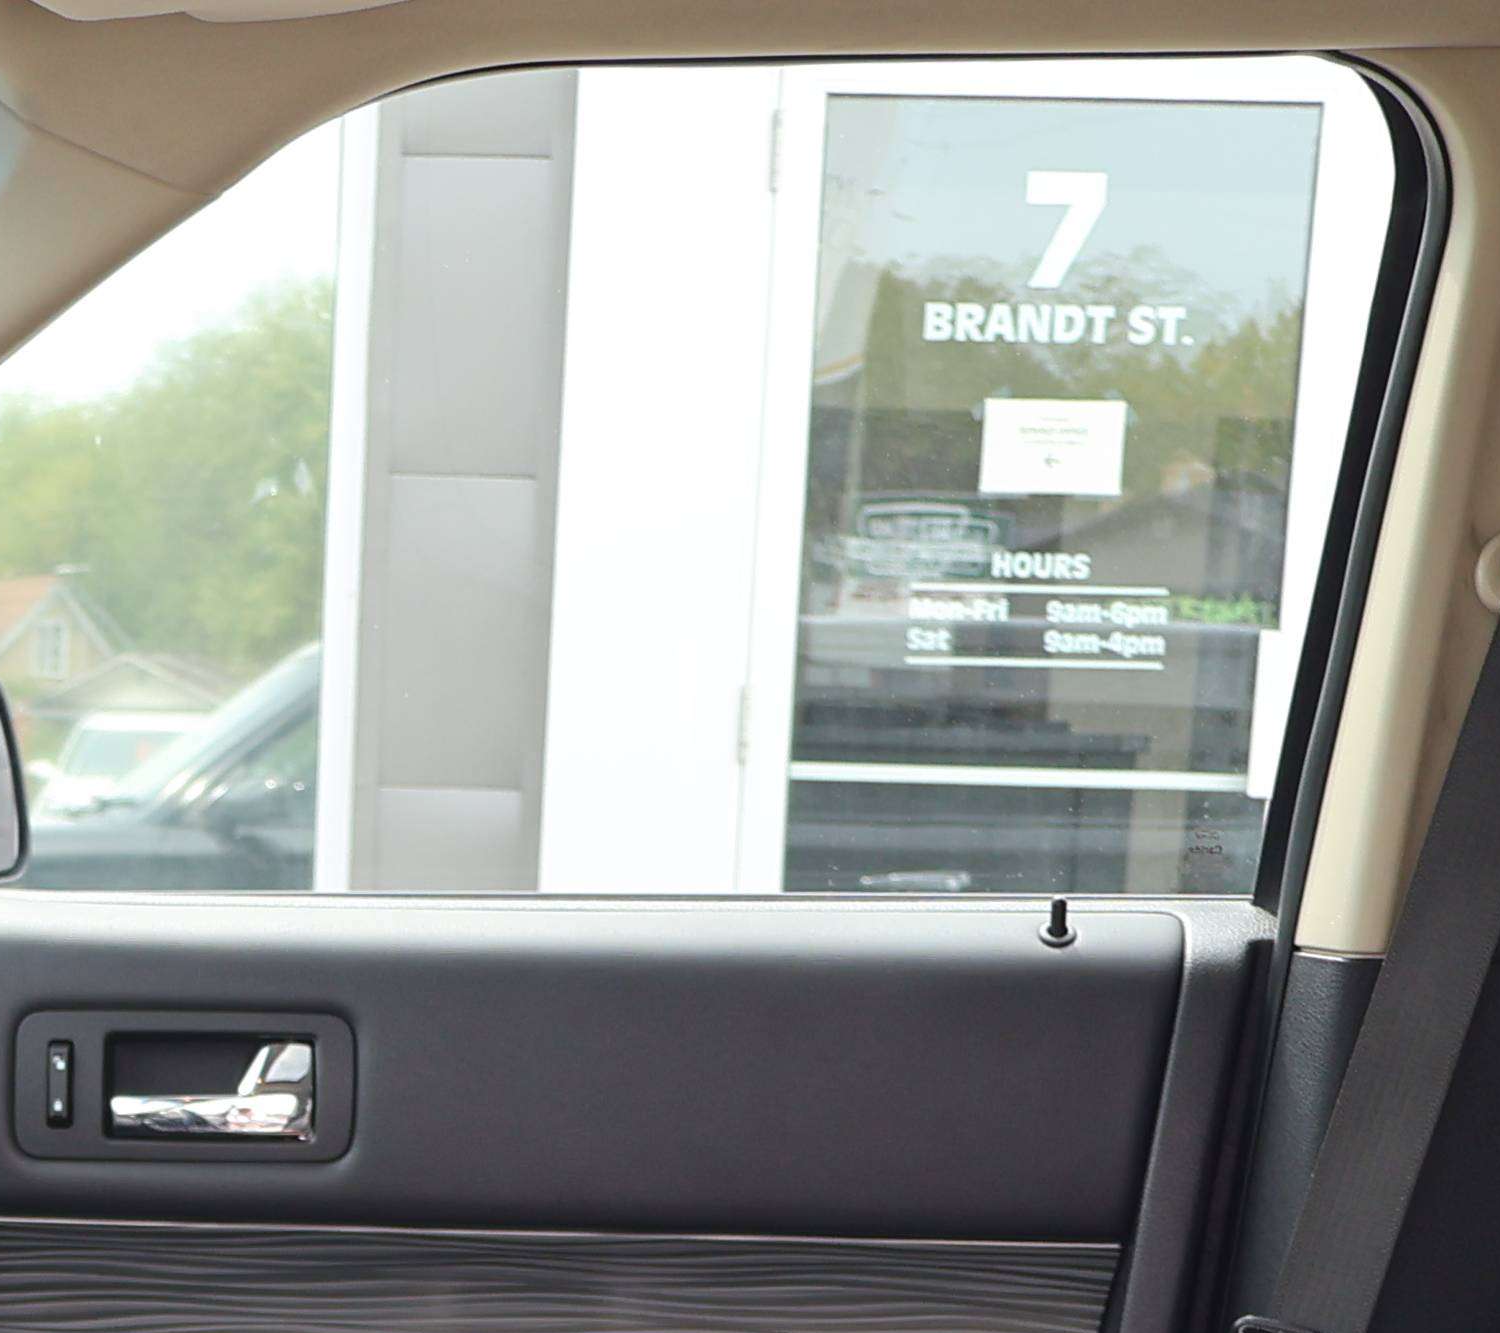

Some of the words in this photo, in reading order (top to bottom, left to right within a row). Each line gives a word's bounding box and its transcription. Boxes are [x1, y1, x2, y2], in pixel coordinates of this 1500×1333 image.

[1025, 171, 1109, 290] 7
[922, 303, 1115, 345] BRANDT
[1127, 305, 1195, 346] ST.
[990, 551, 1092, 579] HOURS
[908, 597, 1009, 622] Mon-Fri
[1045, 600, 1168, 628] 9am-6pm
[905, 626, 952, 652] Sat
[1043, 630, 1166, 658] 9am-4pm
